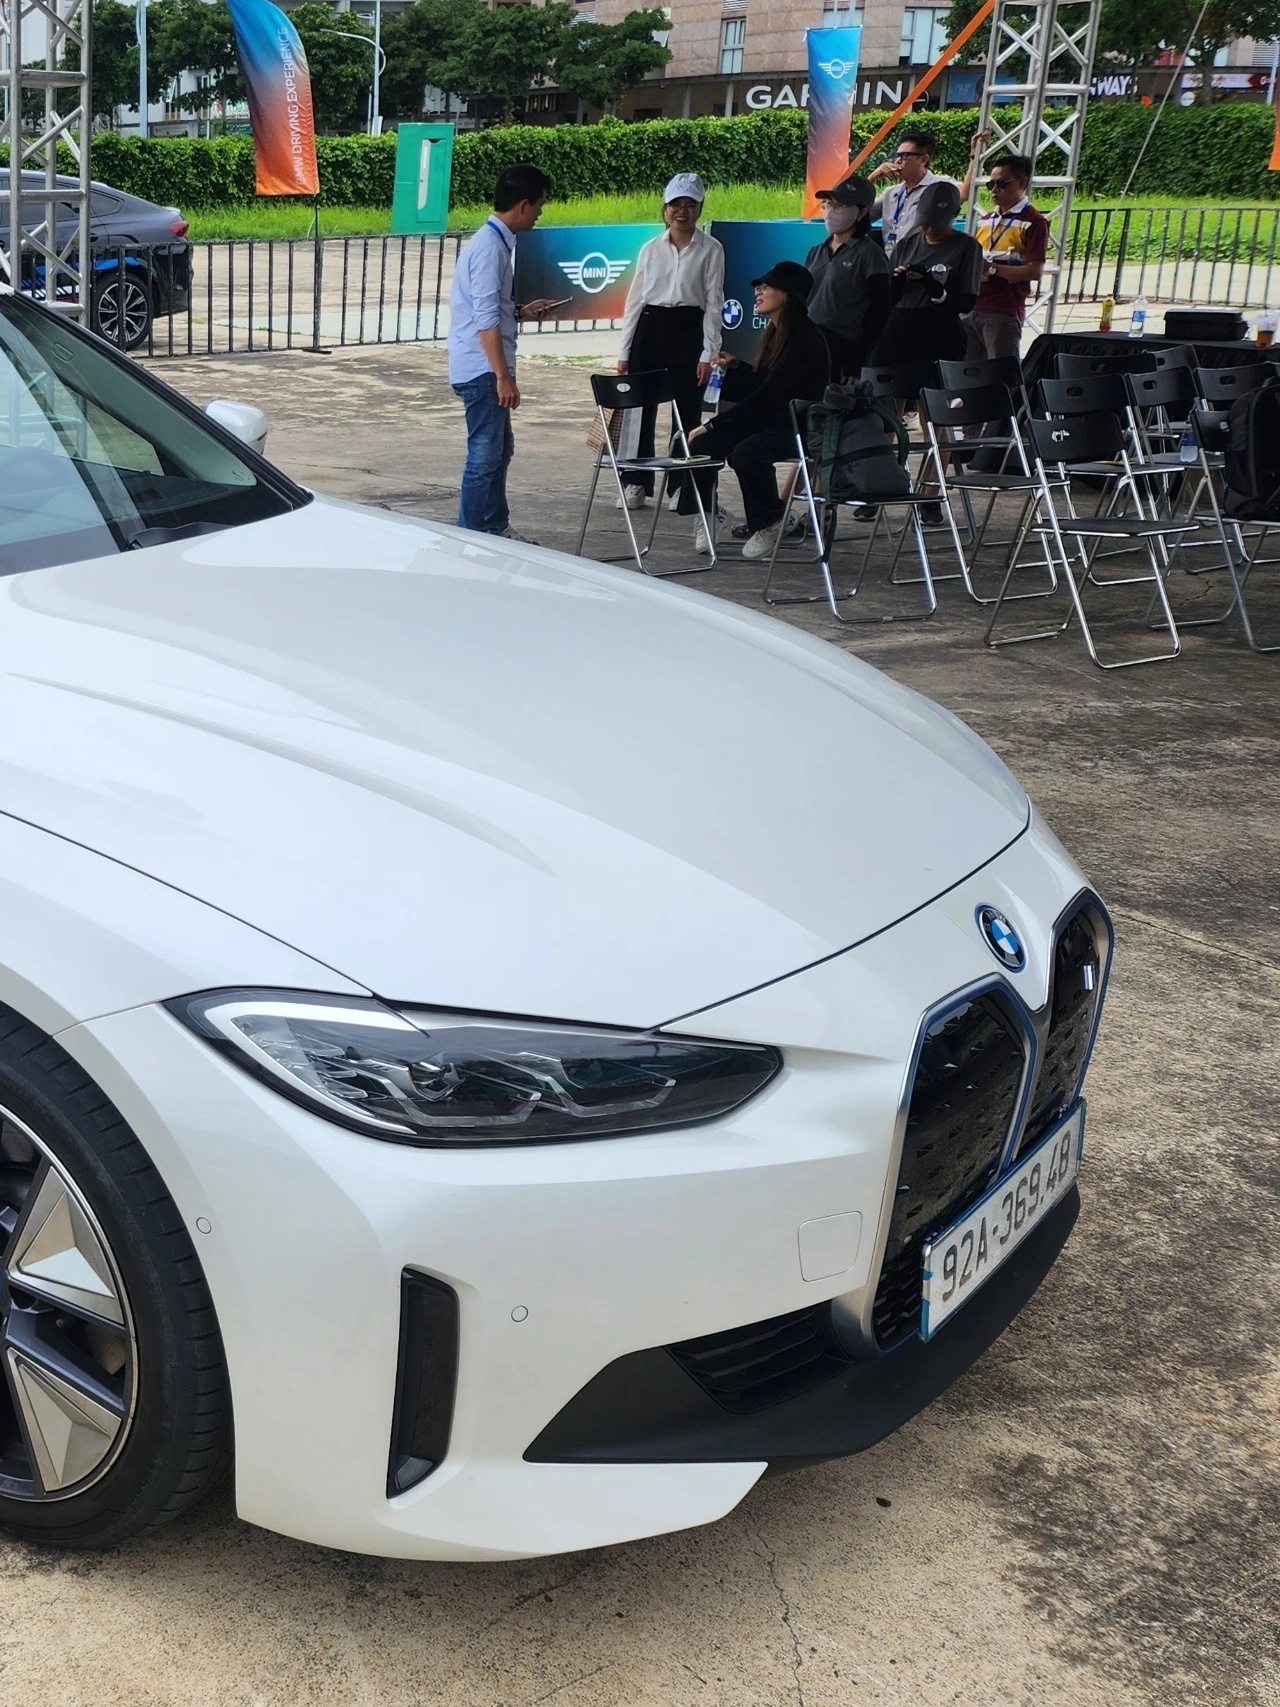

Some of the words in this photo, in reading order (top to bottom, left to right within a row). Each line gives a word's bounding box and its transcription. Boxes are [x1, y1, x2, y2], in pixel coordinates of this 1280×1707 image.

[277, 27, 298, 102] EXPERIENCE
[288, 105, 303, 150] DRIVING
[294, 157, 307, 185] BMW
[583, 267, 606, 279] MINI
[942, 1129, 1071, 1303] 92A-369.48
